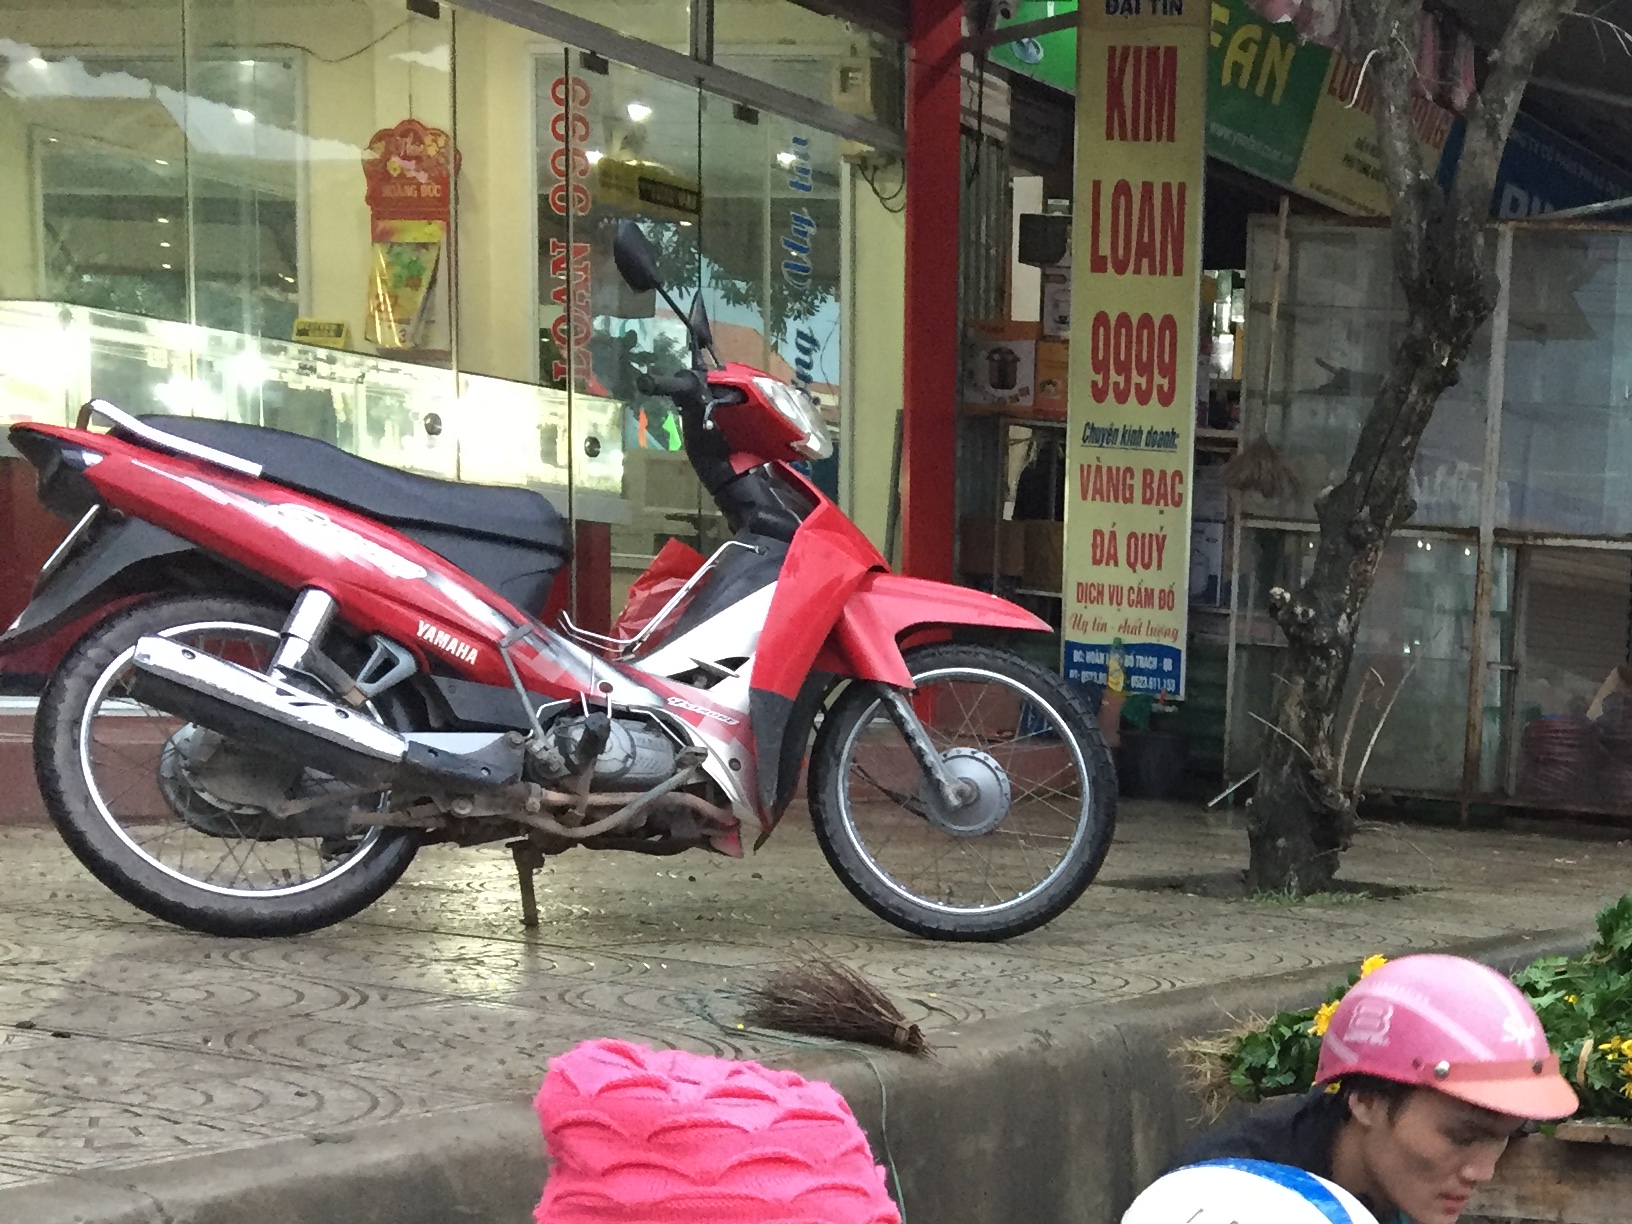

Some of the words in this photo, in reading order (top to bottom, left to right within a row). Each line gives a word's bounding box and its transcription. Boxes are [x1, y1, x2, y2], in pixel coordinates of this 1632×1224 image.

[1105, 46, 1178, 142] KIM
[549, 76, 592, 216] 9999
[1090, 178, 1187, 277] LOAN
[1091, 311, 1178, 408] 9999
[1082, 421, 1119, 448] Chuyên
[1120, 424, 1143, 447] kinh
[1079, 456, 1135, 505] VÀNG
[1142, 468, 1184, 516] BẠC
[1091, 521, 1119, 568] ĐÁ
[1126, 525, 1167, 574] QUÝ
[1076, 581, 1105, 610] DỊCH
[1108, 583, 1124, 613] VỤ
[417, 620, 478, 665] YAMAHA
